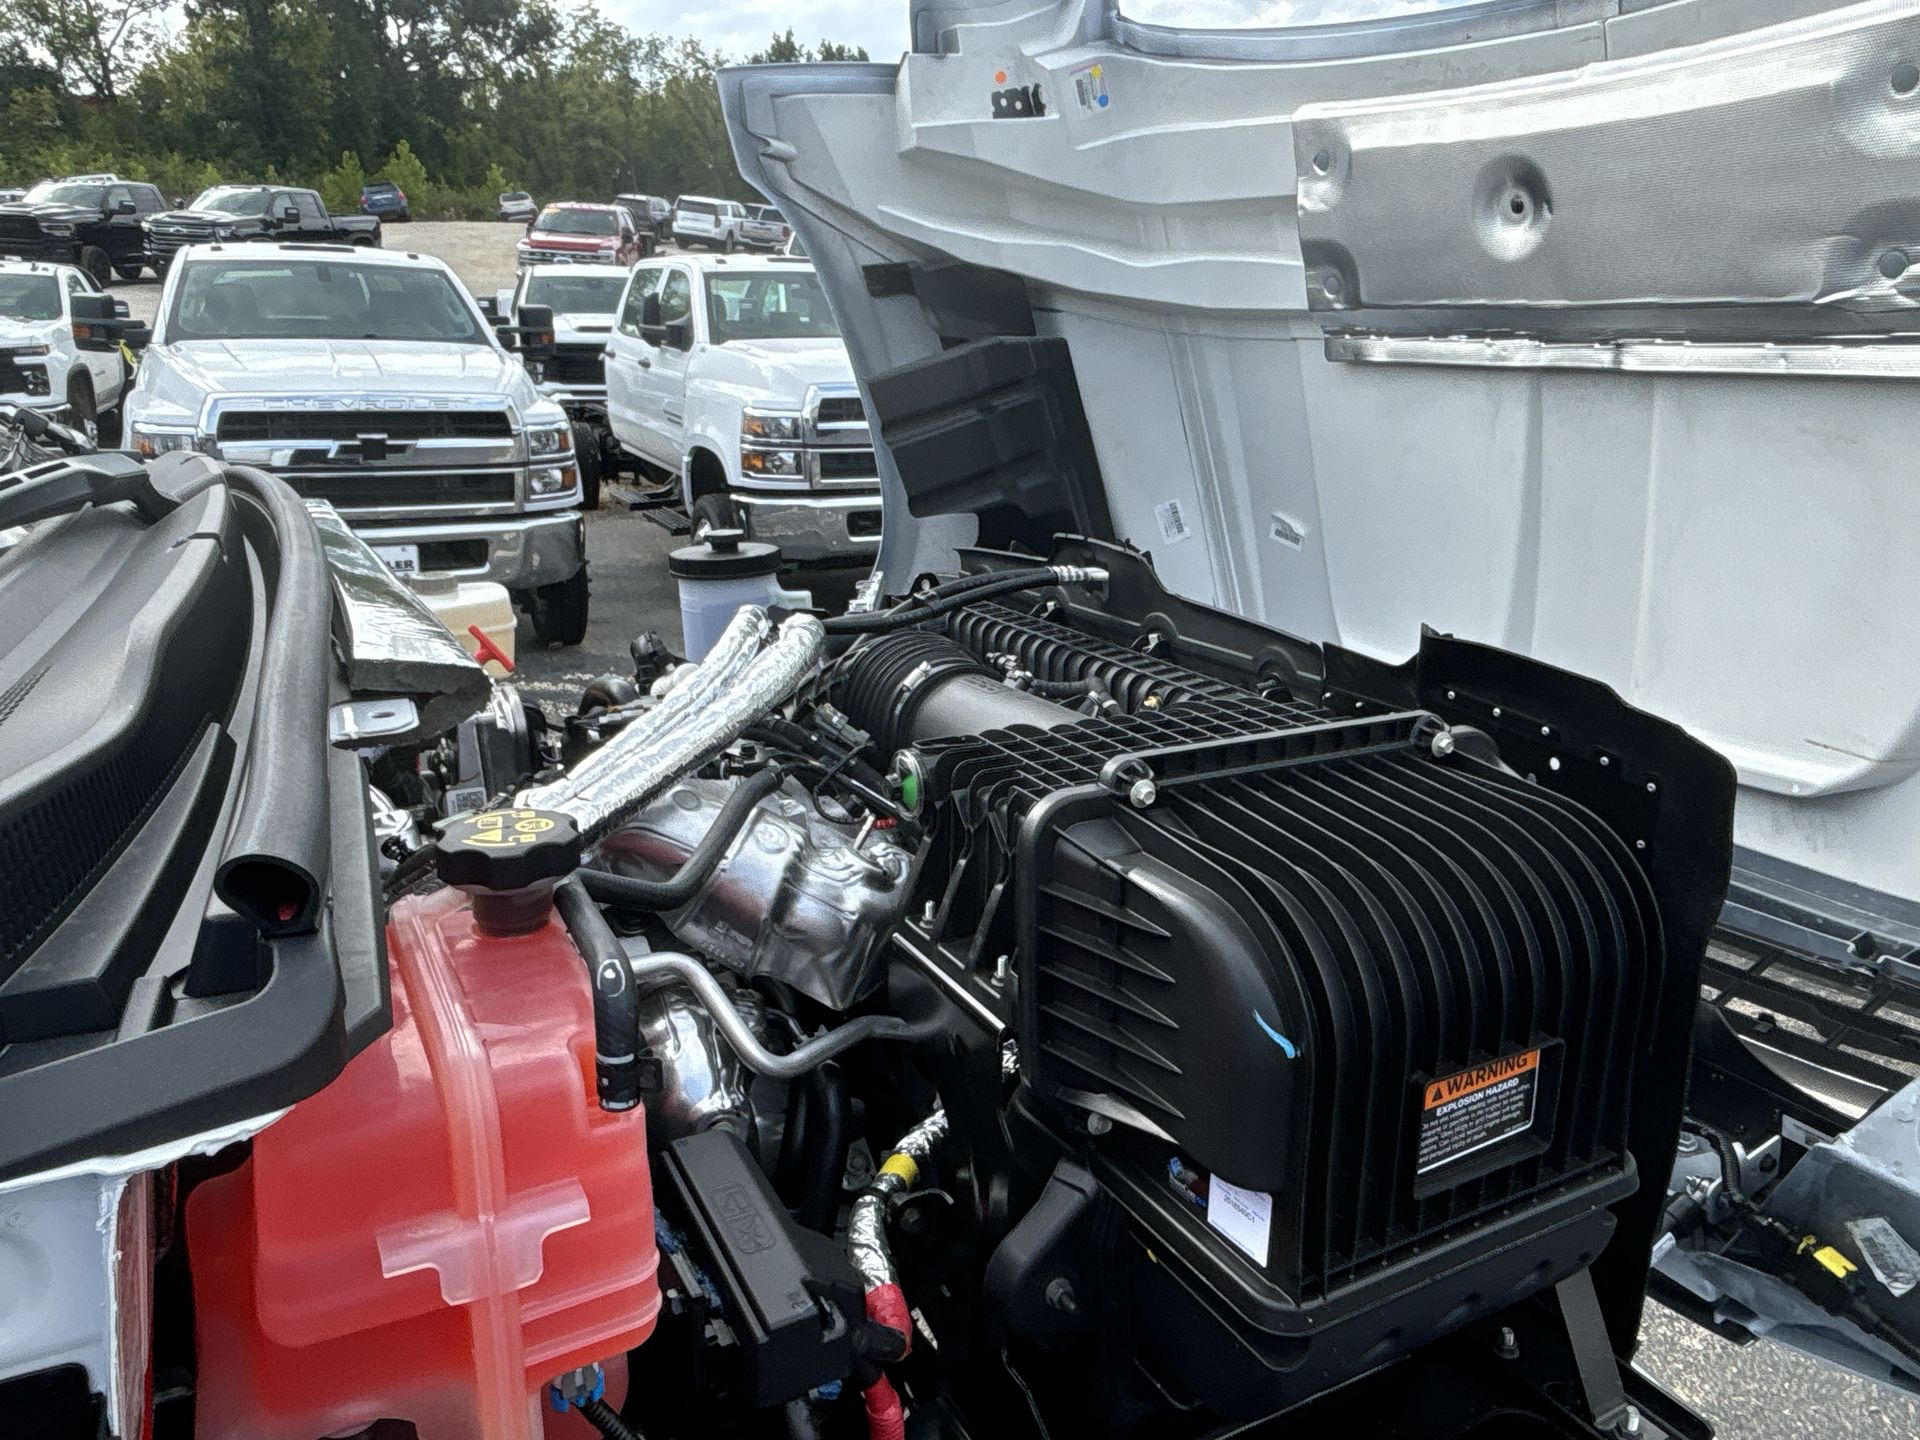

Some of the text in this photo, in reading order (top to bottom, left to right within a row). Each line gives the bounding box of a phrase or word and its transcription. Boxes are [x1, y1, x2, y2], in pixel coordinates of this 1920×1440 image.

[263, 399, 469, 409] CHEVROLET
[1446, 1055, 1528, 1096] WARNING
[1436, 1091, 1484, 1117] EXPLOSION
[1485, 1077, 1520, 1097] HAZARD
